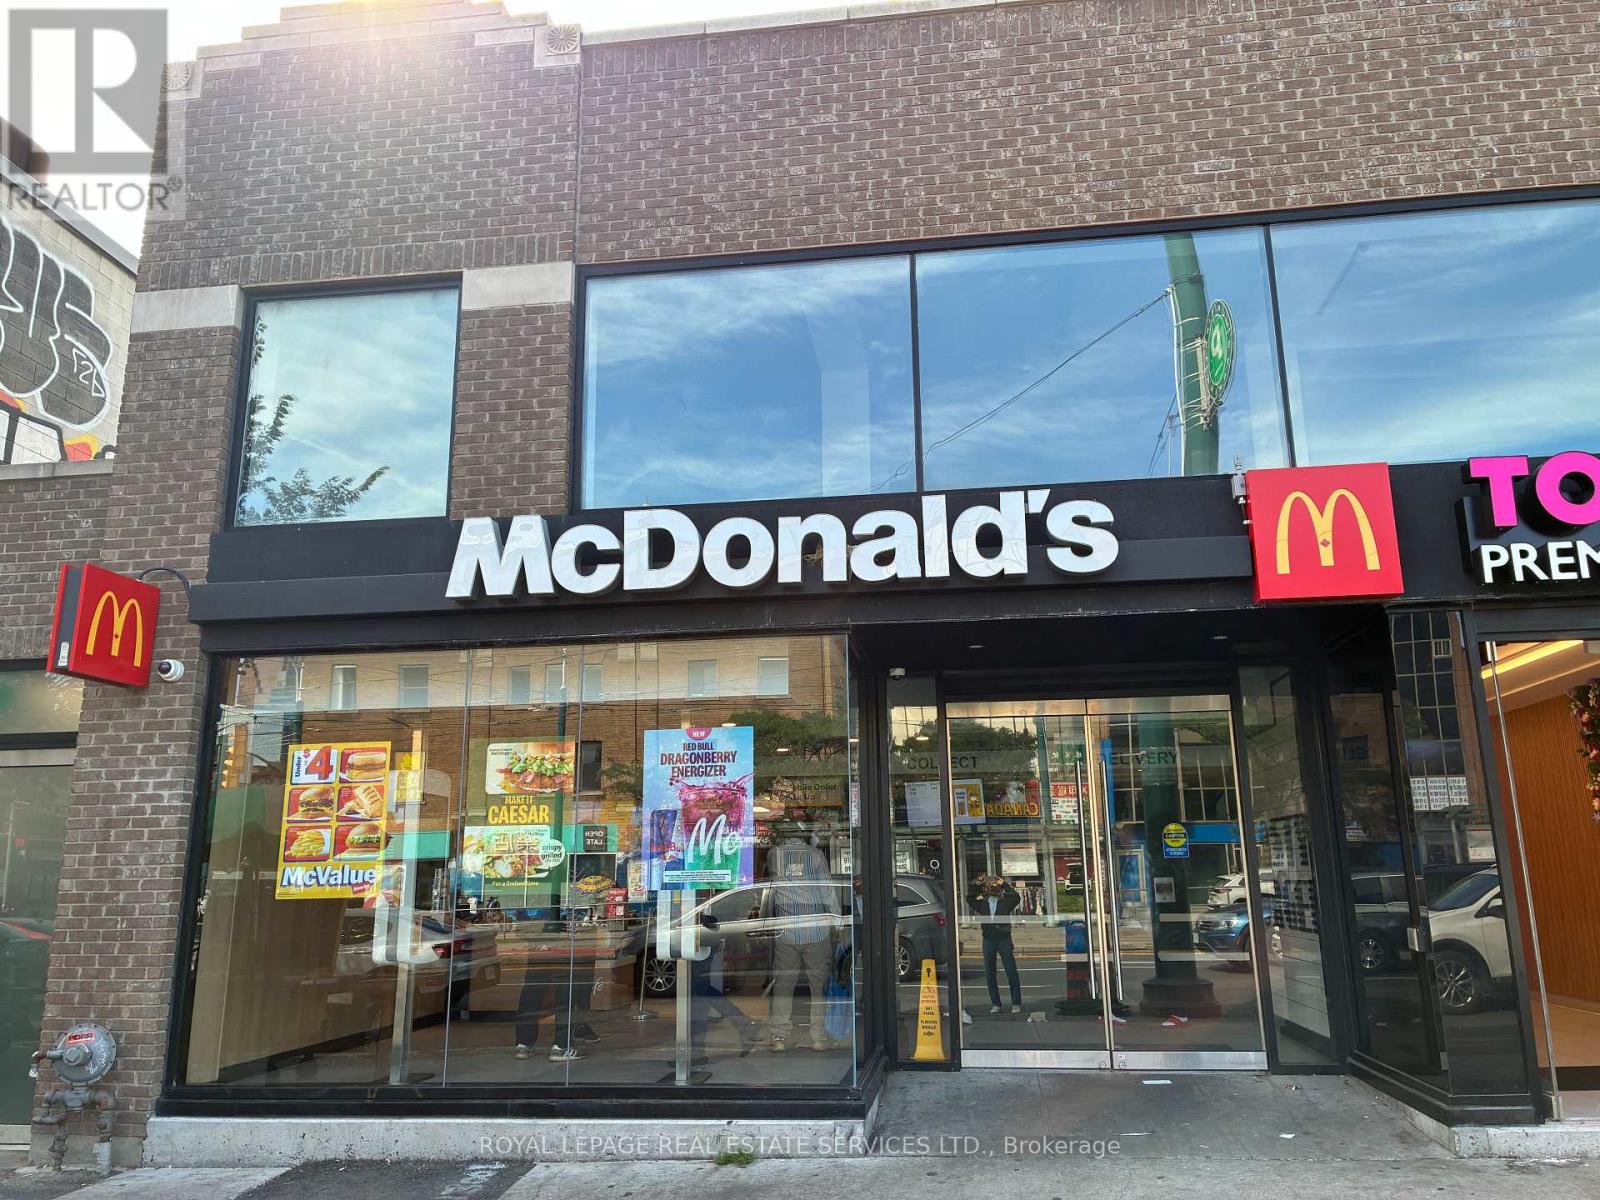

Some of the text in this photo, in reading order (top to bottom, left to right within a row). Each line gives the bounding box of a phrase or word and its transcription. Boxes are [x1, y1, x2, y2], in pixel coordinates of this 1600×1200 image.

[1470, 450, 1600, 528] TO
[445, 488, 1120, 599] McDonald's
[683, 742, 714, 751] RED BULL
[660, 751, 737, 765] DRAGONBERRY
[907, 756, 978, 770] COLECT
[1101, 751, 1177, 765] ELVERY
[294, 756, 302, 778] Under
[671, 764, 727, 778] ENERGIZER
[505, 795, 533, 804] MAKE IT
[488, 804, 550, 824] CAESAR
[541, 844, 562, 853] crispy
[541, 852, 562, 861] grilled
[281, 864, 378, 888] McValue
